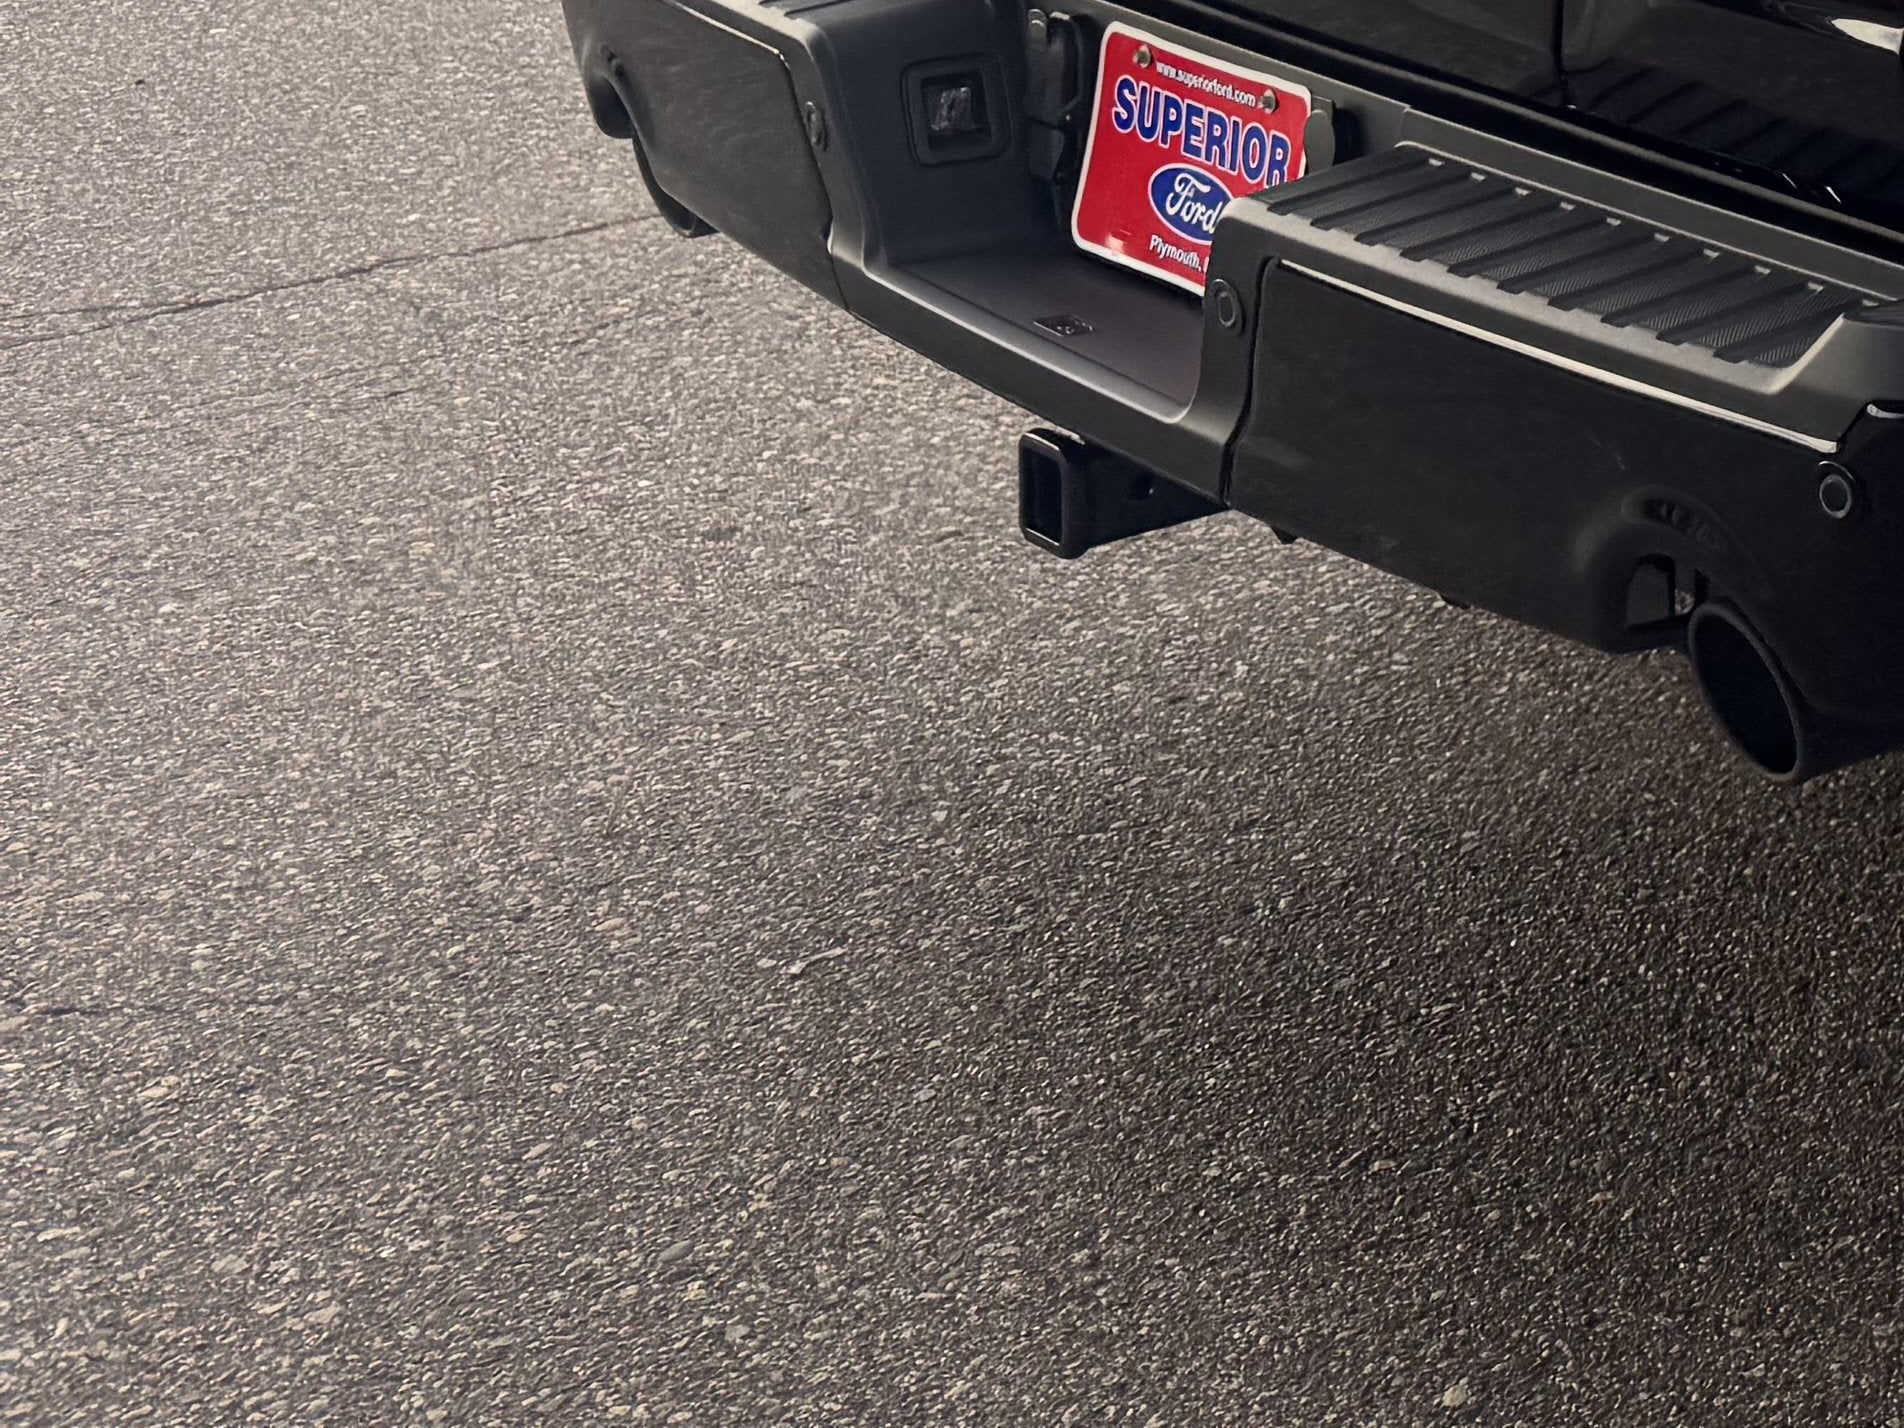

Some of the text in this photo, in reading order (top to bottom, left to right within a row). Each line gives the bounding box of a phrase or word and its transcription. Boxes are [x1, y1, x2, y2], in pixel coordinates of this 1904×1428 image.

[1156, 61, 1257, 107] www.superiorford.com
[1112, 74, 1291, 189] SUPERIOR
[1165, 172, 1223, 234] Ford
